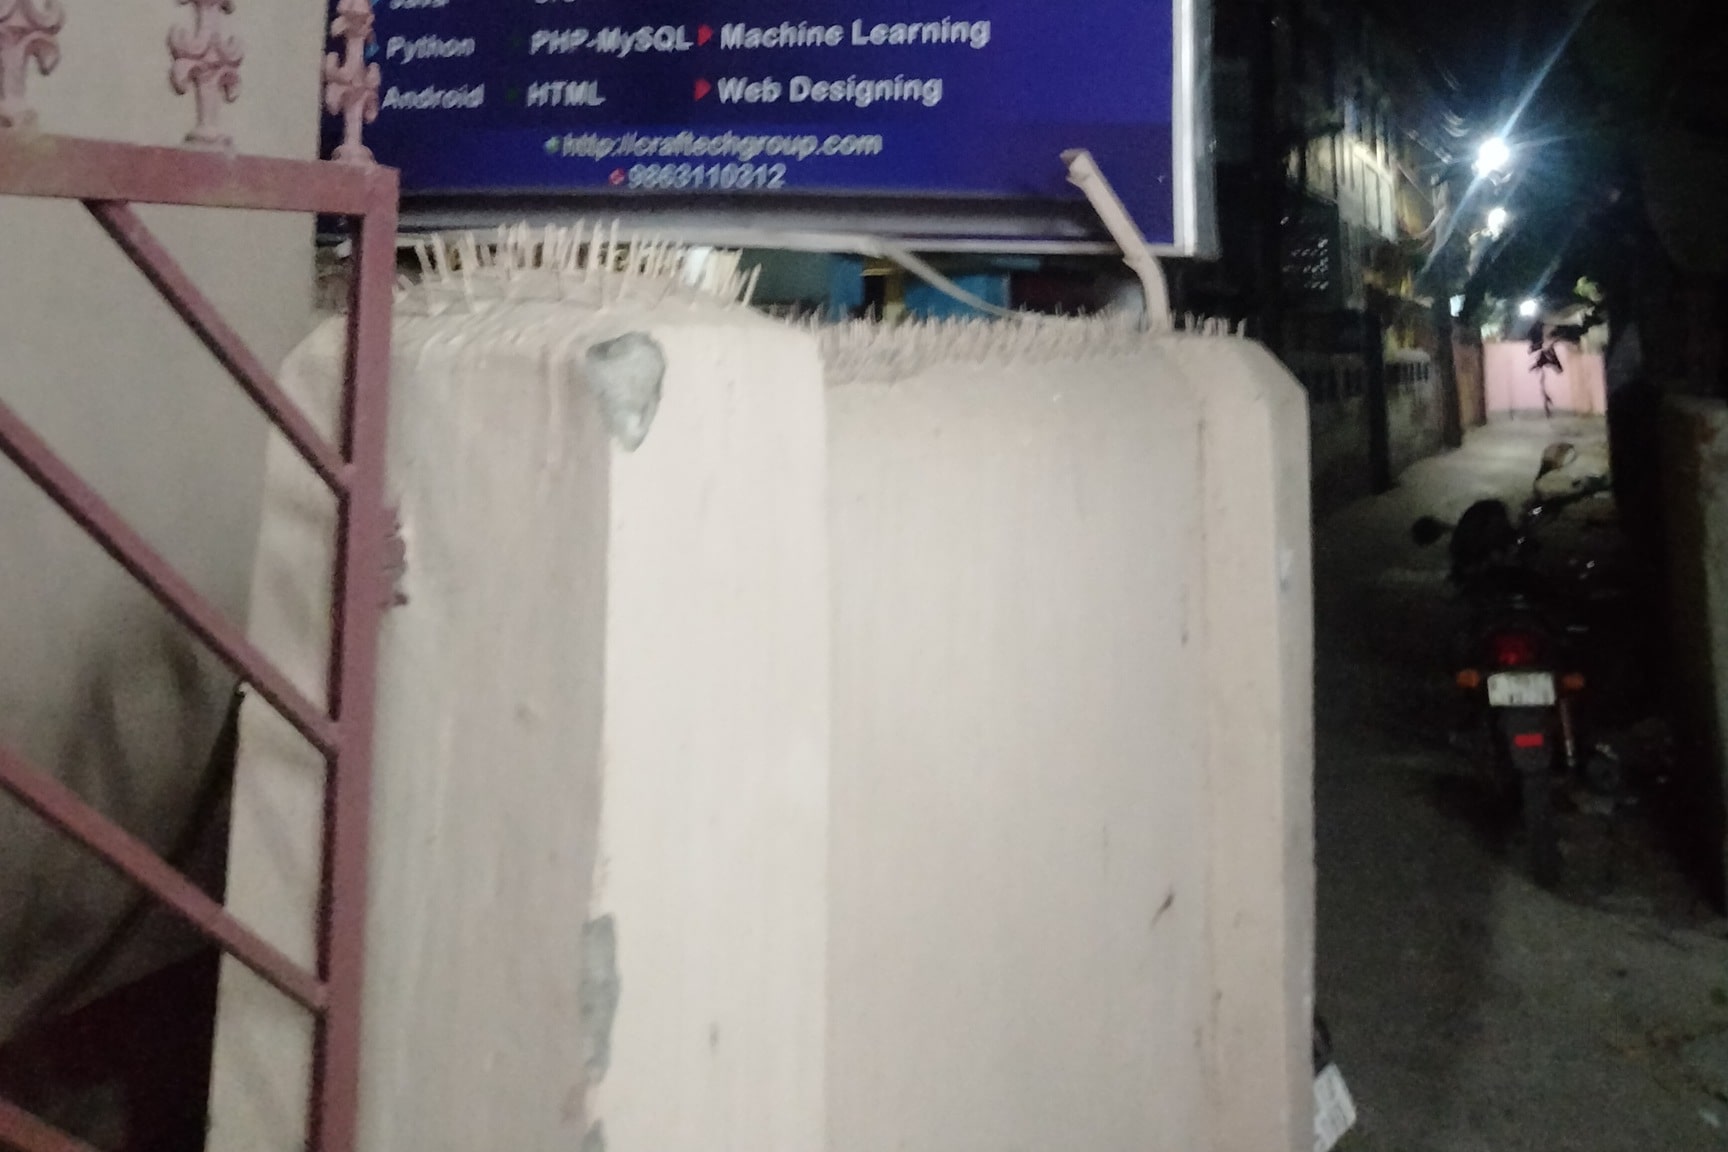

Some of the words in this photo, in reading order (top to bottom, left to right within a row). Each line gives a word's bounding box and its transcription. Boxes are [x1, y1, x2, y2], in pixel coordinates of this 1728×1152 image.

[529, 24, 694, 59] PHP-MySQL
[720, 20, 844, 50] Machine
[851, 15, 992, 49] Learning
[386, 35, 476, 64] Python
[381, 83, 486, 110] Android
[526, 80, 606, 108] HTML
[717, 77, 783, 104] Web
[789, 74, 944, 108] Designing
[628, 162, 787, 190] 9863110312
